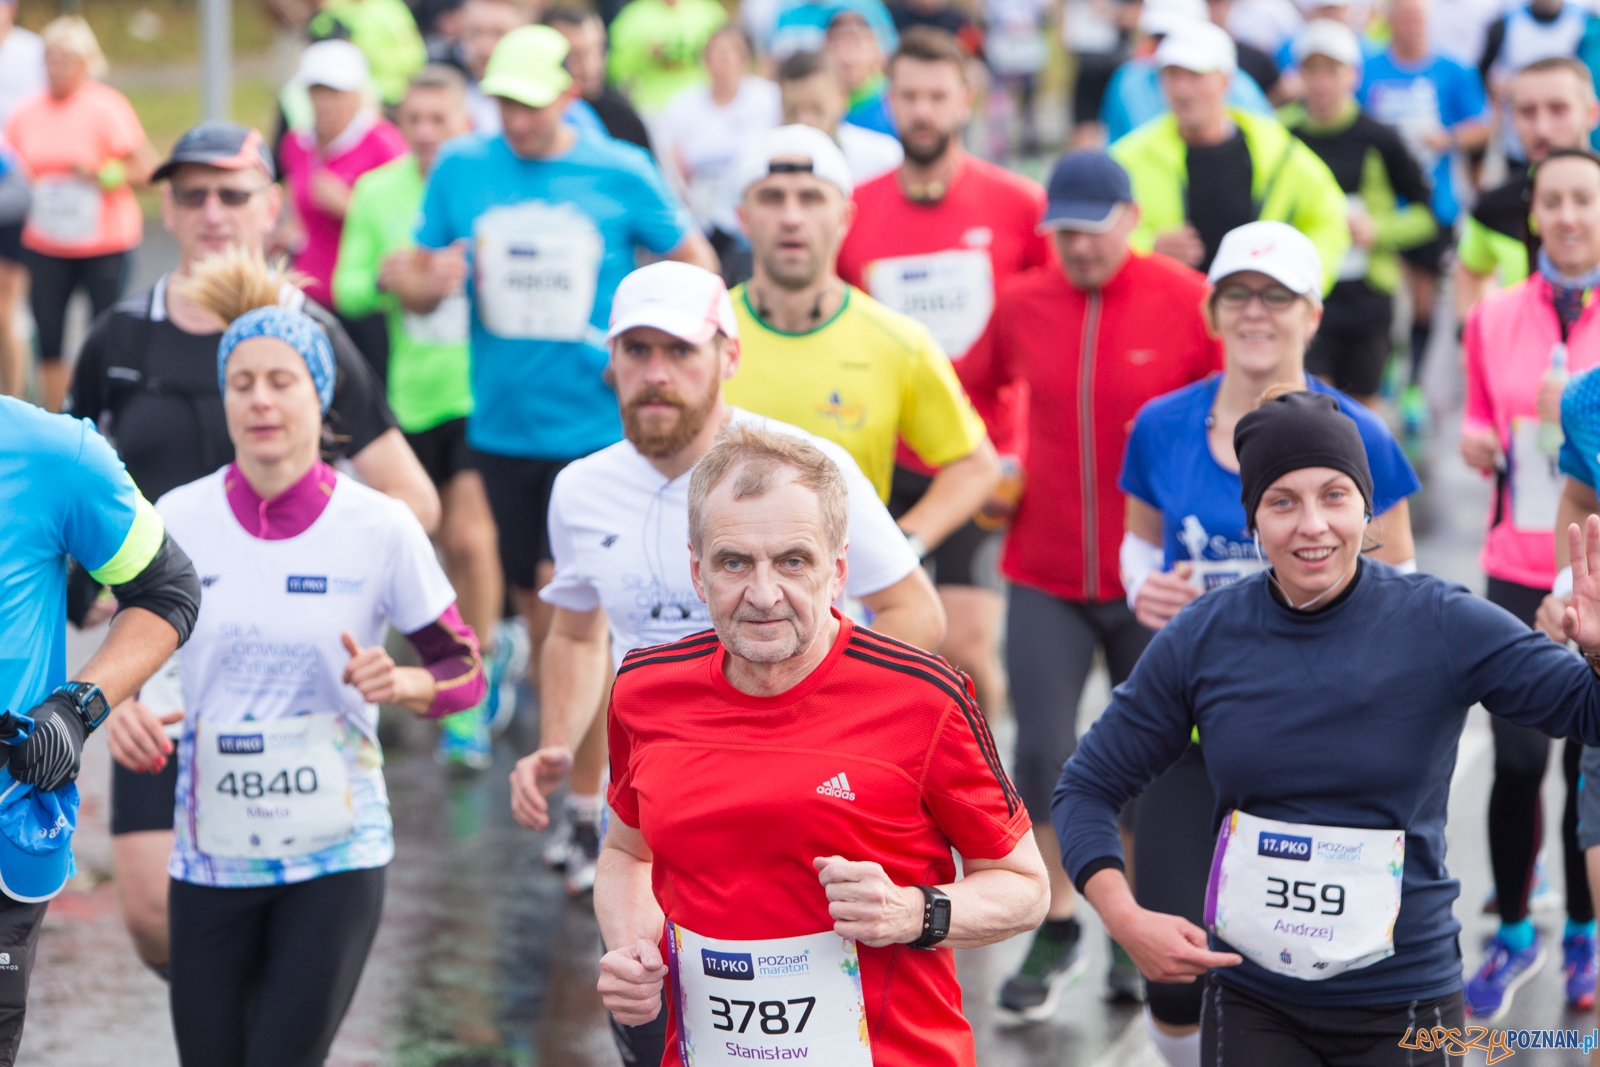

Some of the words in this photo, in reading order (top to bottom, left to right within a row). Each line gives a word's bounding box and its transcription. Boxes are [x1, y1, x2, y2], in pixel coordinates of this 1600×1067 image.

[216, 766, 318, 798] 4840
[816, 785, 856, 801] adidas
[1262, 838, 1309, 855] 17.PKO
[1265, 876, 1346, 916] 359
[1273, 919, 1335, 941] Andrzej
[705, 957, 749, 973] 17.PKO
[759, 963, 809, 975] maraton
[708, 995, 816, 1034] 3787
[725, 1042, 808, 1060] Stanisław
